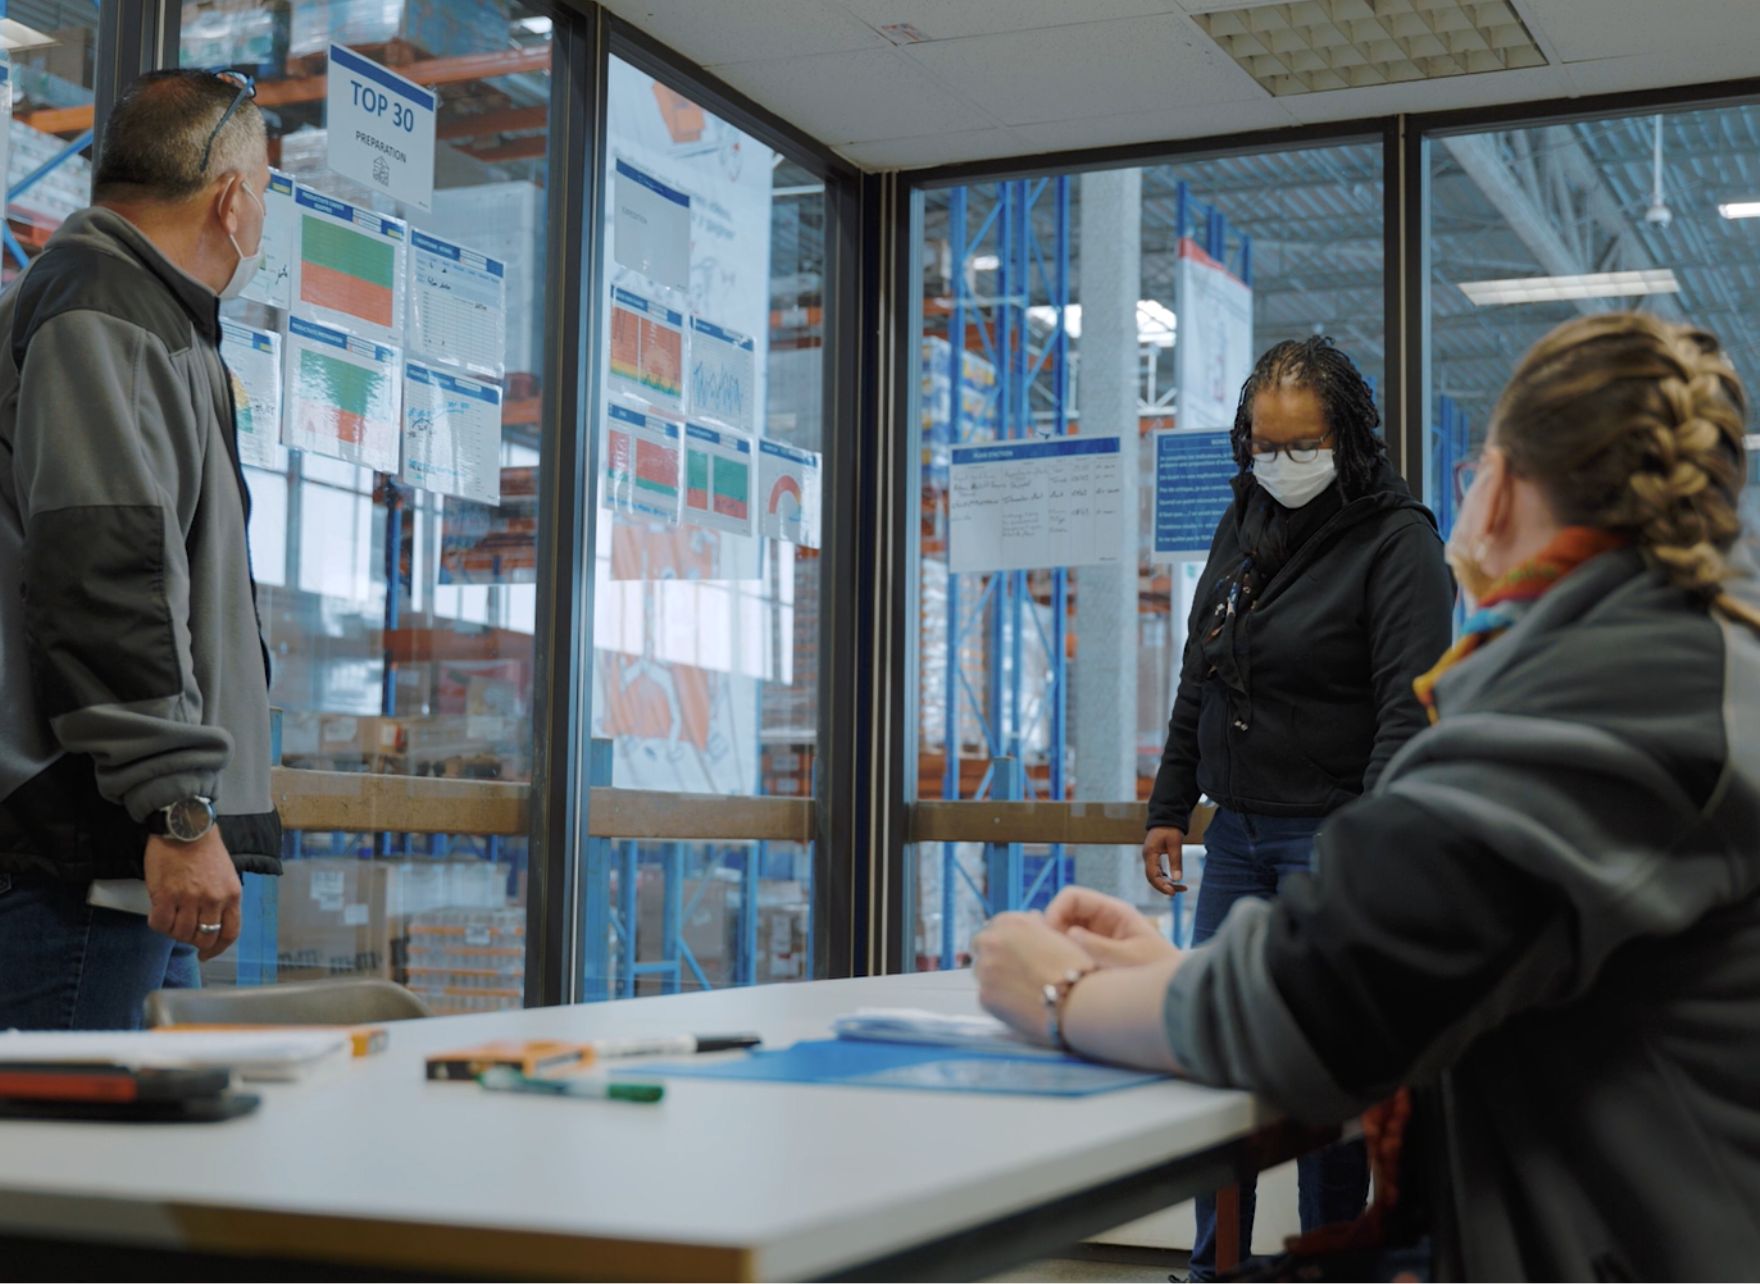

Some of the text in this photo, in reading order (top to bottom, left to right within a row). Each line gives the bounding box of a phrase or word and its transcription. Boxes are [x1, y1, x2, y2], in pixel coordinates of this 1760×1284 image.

[351, 80, 414, 133] TOP 30
[355, 130, 407, 164] PREPARATION
